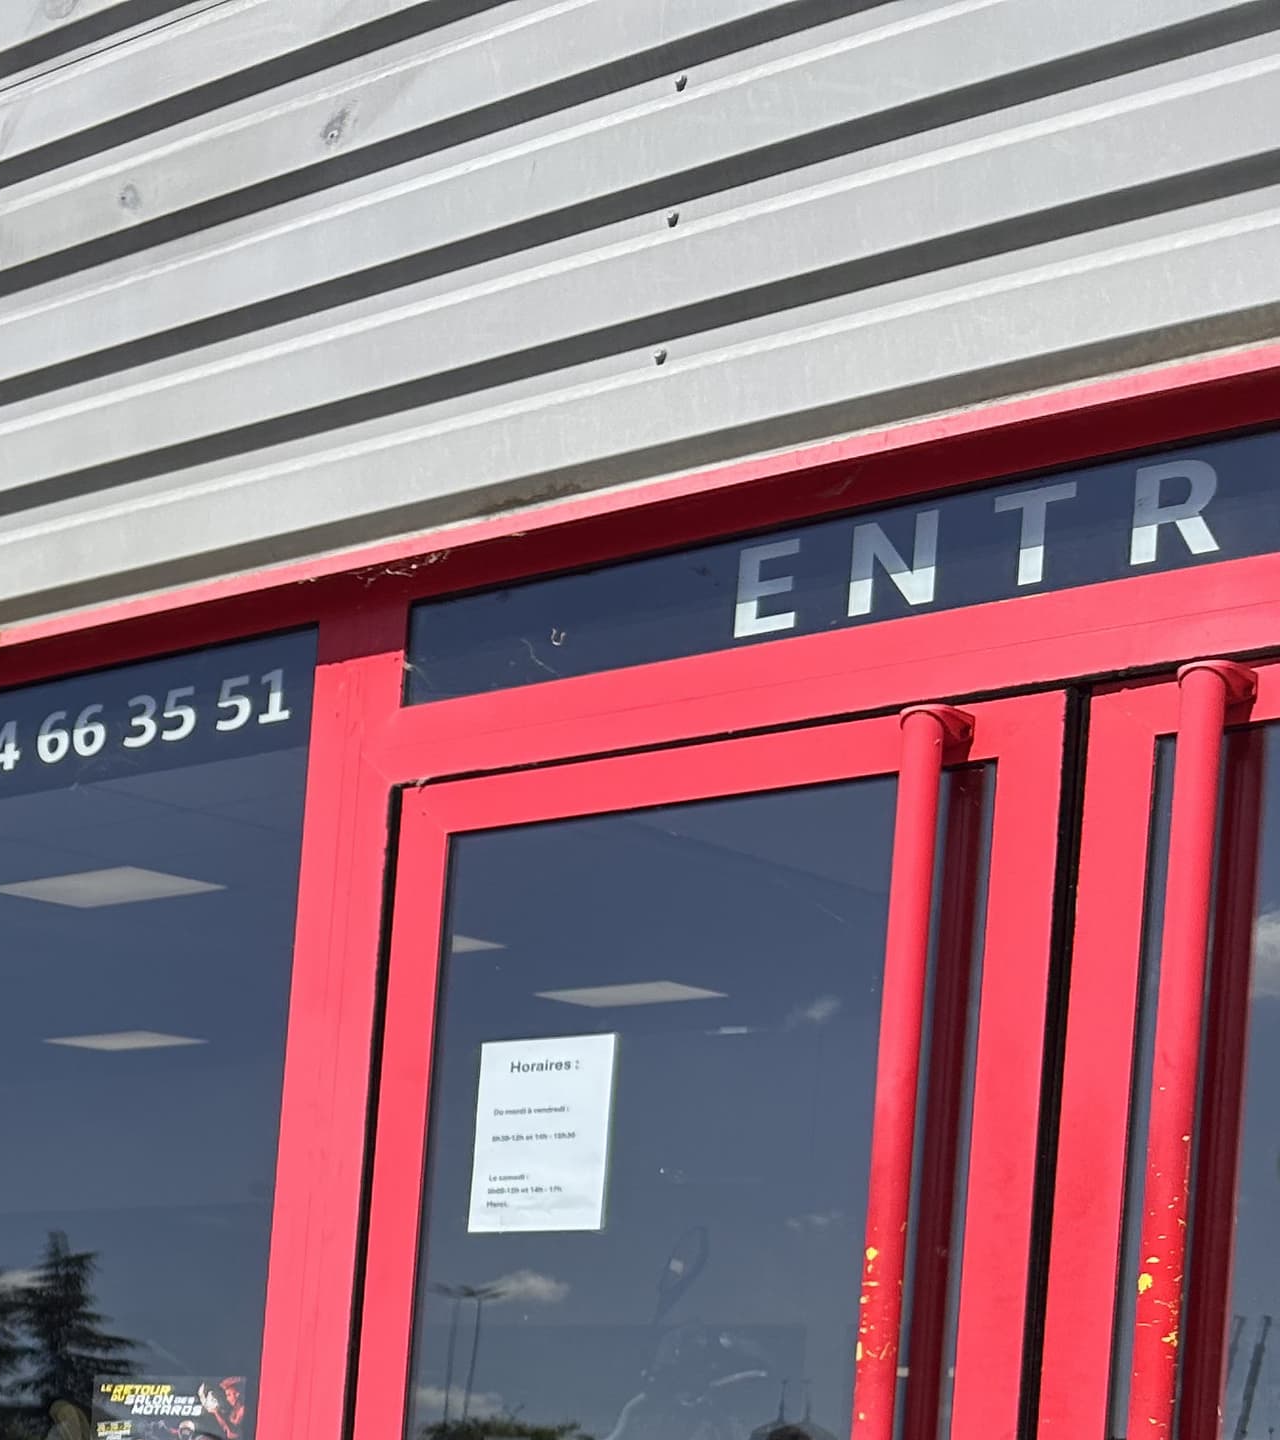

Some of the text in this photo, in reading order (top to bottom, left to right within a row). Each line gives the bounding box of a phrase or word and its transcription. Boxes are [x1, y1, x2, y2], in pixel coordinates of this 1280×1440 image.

[732, 458, 1221, 640] ENTR
[36, 703, 106, 765] 66
[122, 685, 197, 749] 35
[214, 668, 292, 732] 51
[509, 1059, 572, 1074] Horaires
[100, 1383, 171, 1395] LE RETOUR
[110, 1393, 125, 1403] DU
[124, 1394, 174, 1406] SALON
[130, 1403, 203, 1417] MOTARDS
